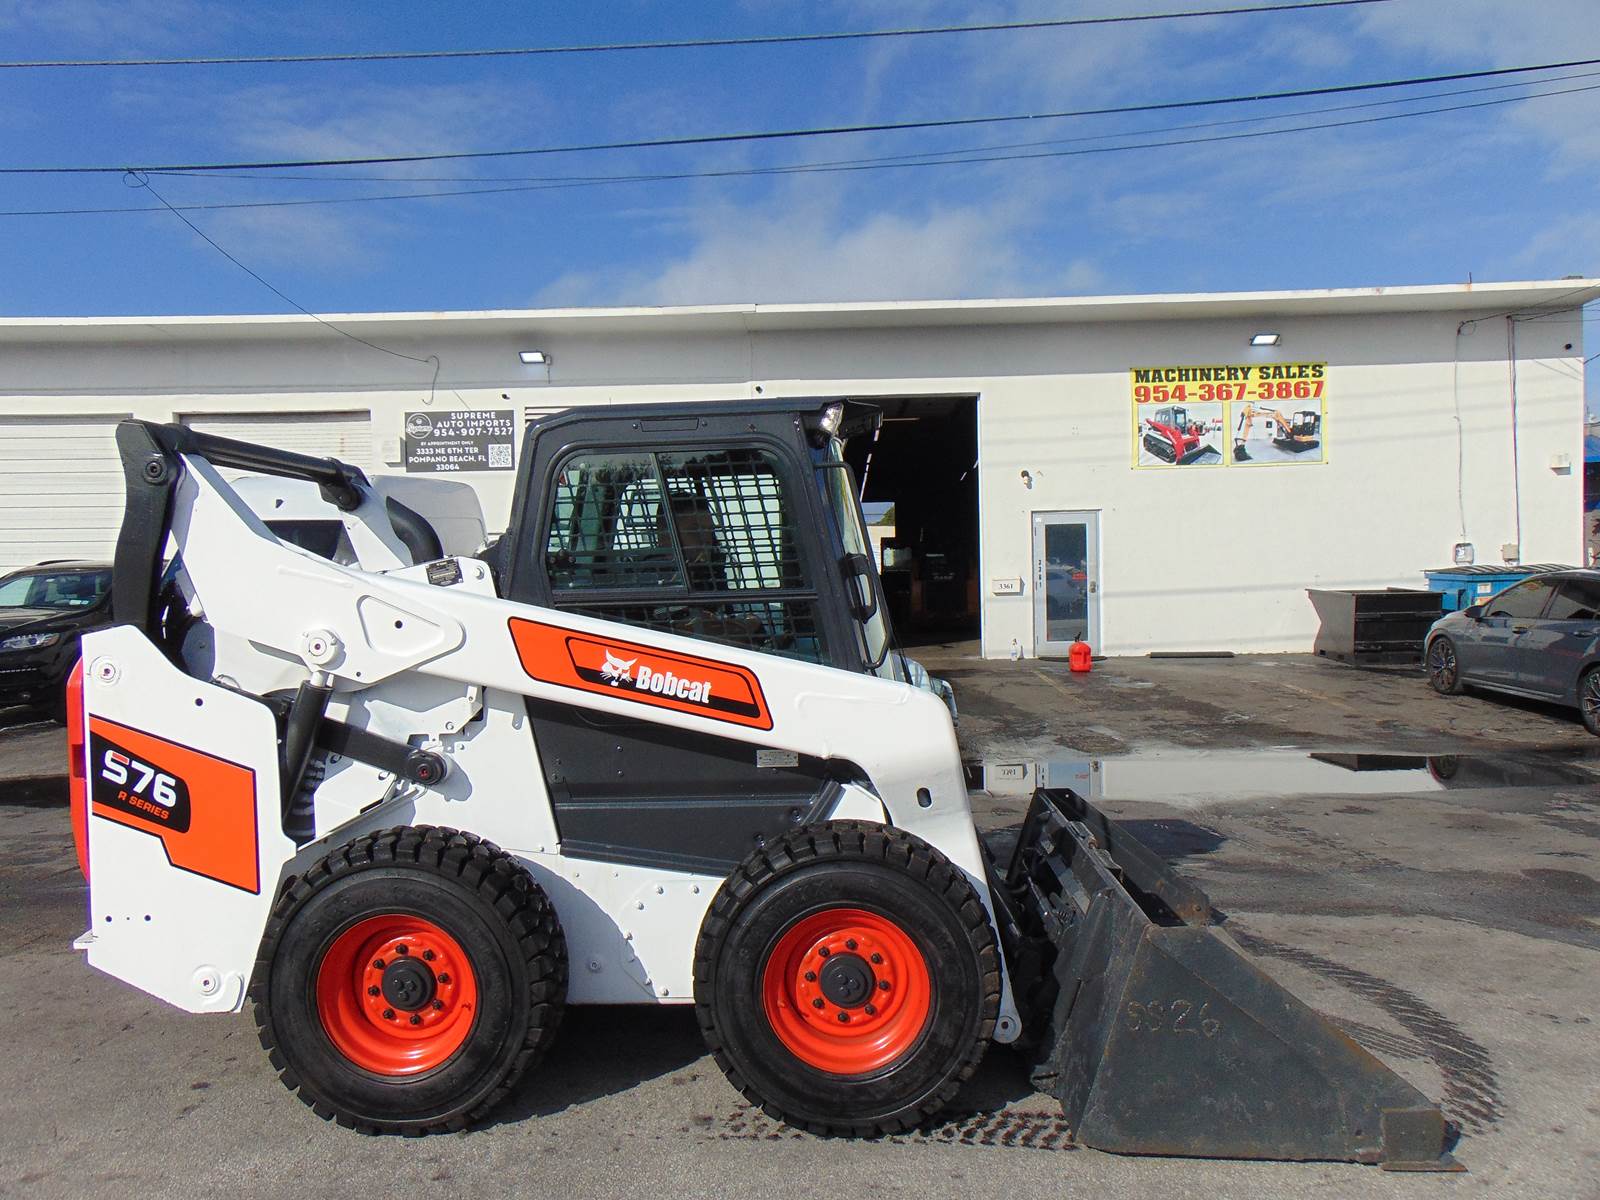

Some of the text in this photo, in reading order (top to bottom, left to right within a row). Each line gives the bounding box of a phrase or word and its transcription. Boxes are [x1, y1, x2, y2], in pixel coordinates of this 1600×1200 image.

[1135, 365, 1324, 383] MACHINERY SALES
[1134, 380, 1324, 403] 954-367-3867
[436, 419, 511, 428] AUTO IMPORTS
[451, 412, 496, 420] SUPREME
[433, 427, 513, 437] 954-907-7527
[449, 455, 477, 463] BEACH,
[635, 665, 712, 704] Bobcat
[102, 749, 177, 808] S76
[117, 790, 170, 820] R SERIES
